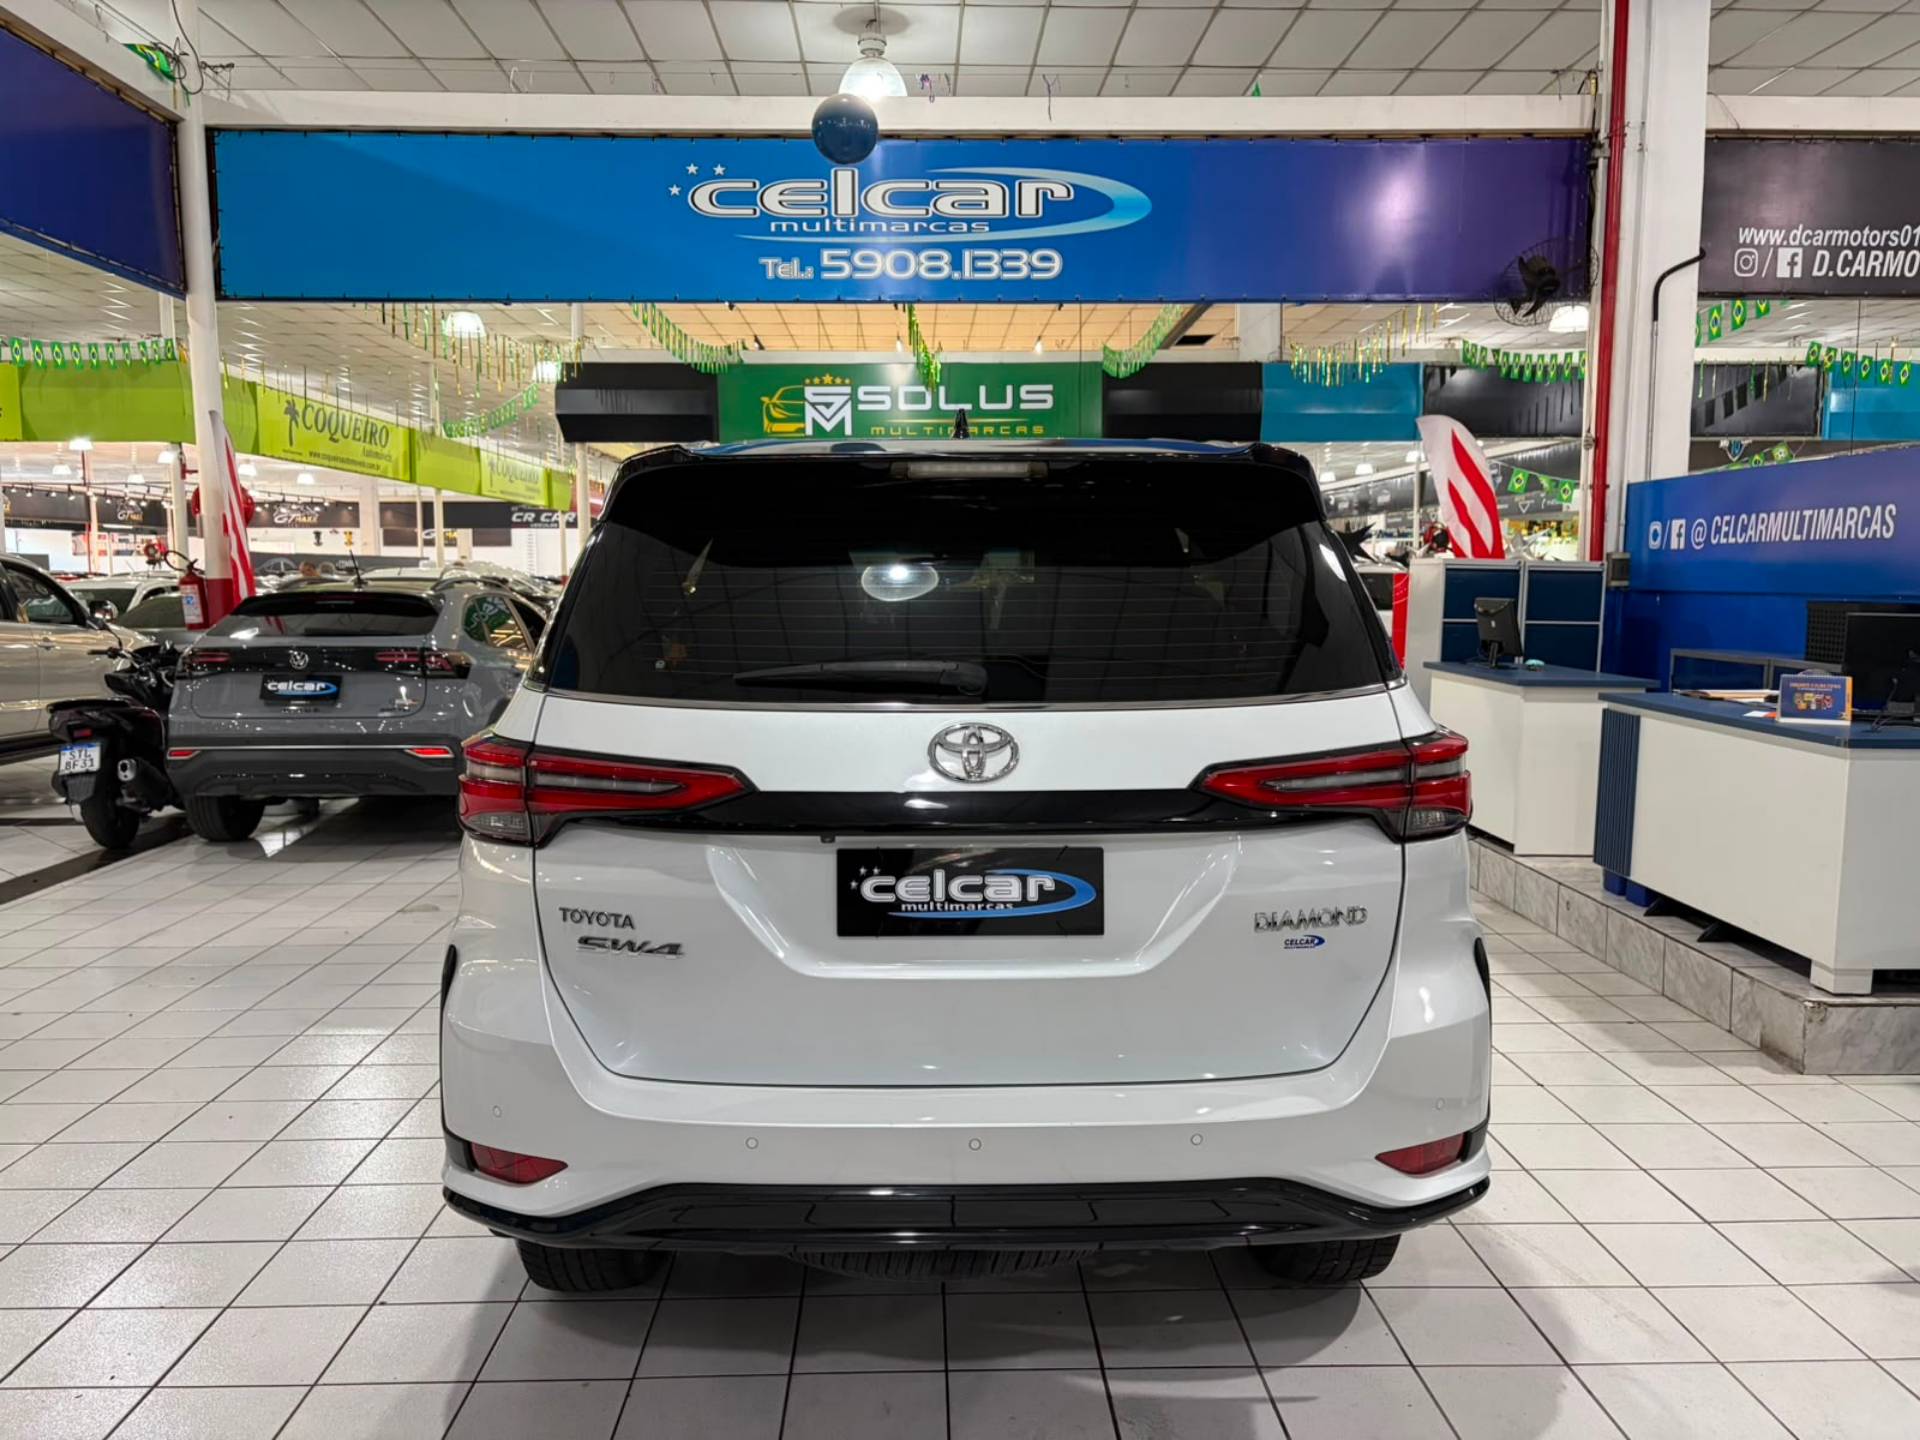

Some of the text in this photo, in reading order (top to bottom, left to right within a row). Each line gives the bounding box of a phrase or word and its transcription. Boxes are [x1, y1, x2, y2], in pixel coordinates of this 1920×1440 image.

[688, 167, 1075, 218] celcar
[769, 218, 991, 233] multimarcas
[820, 248, 1063, 280] 5908.1339
[857, 384, 1054, 410] SOLUS
[302, 404, 389, 448] COQUEIRO
[511, 512, 536, 522] CR
[860, 869, 1056, 902] celcar
[559, 907, 635, 929] TOYOTA
[901, 901, 1014, 911] multimarcas
[1254, 906, 1368, 932] DIAMOND
